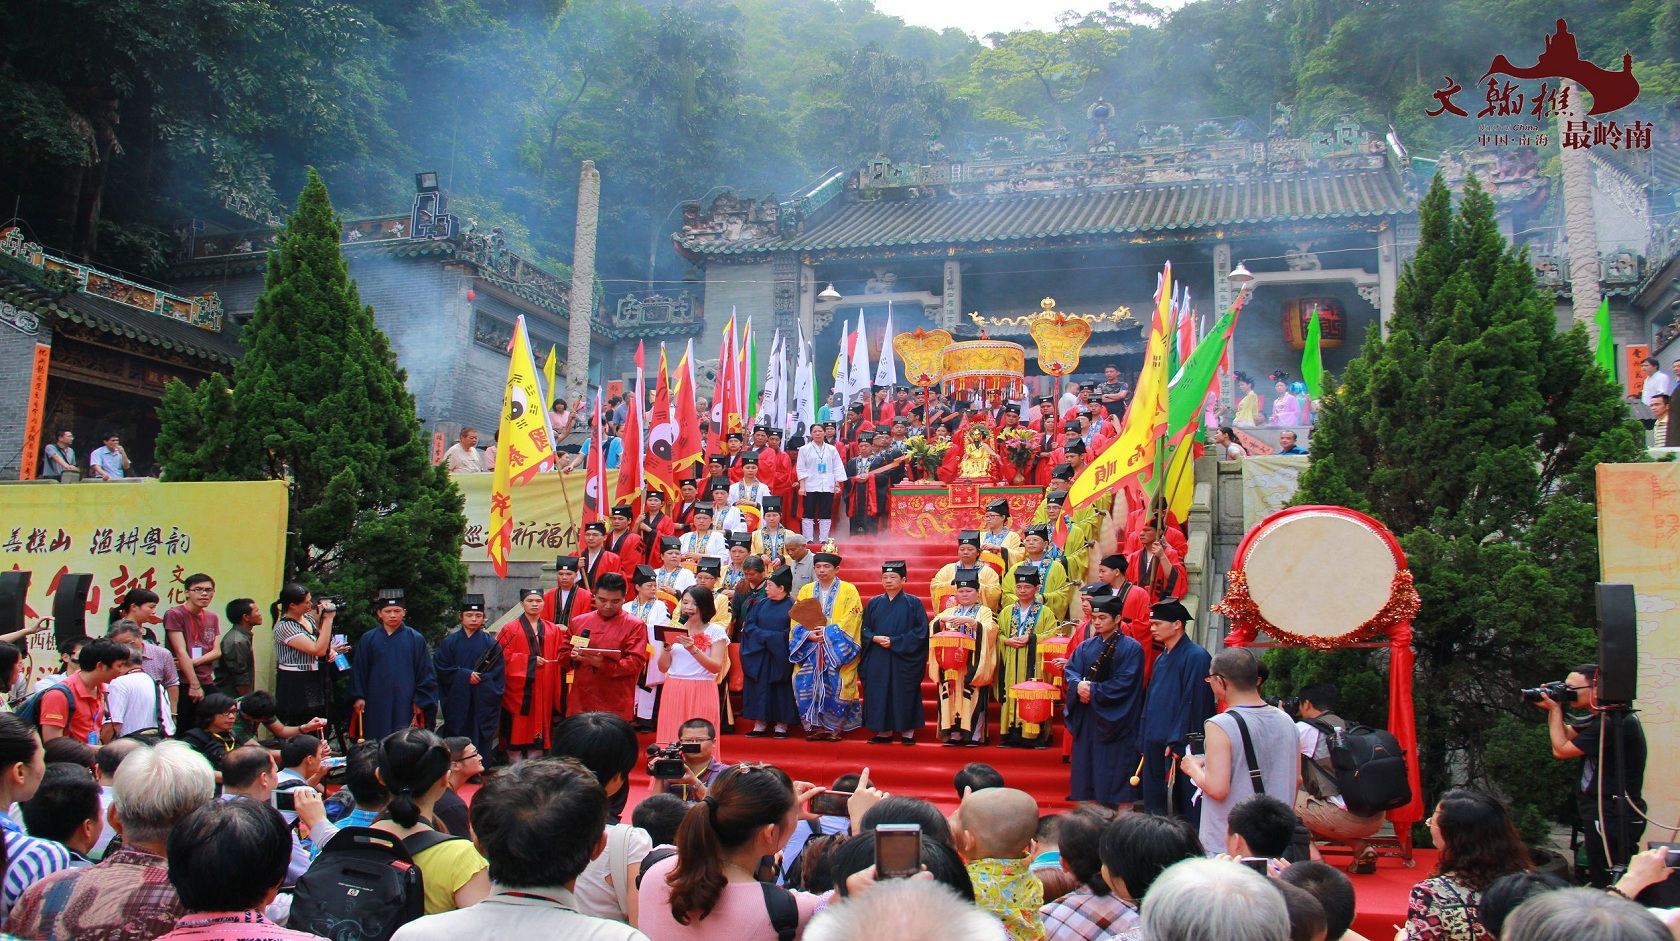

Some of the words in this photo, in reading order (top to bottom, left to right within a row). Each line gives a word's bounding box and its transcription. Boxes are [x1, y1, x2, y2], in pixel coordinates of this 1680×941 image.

[463, 520, 581, 550] 巡祈福
[167, 564, 186, 605] 文化
